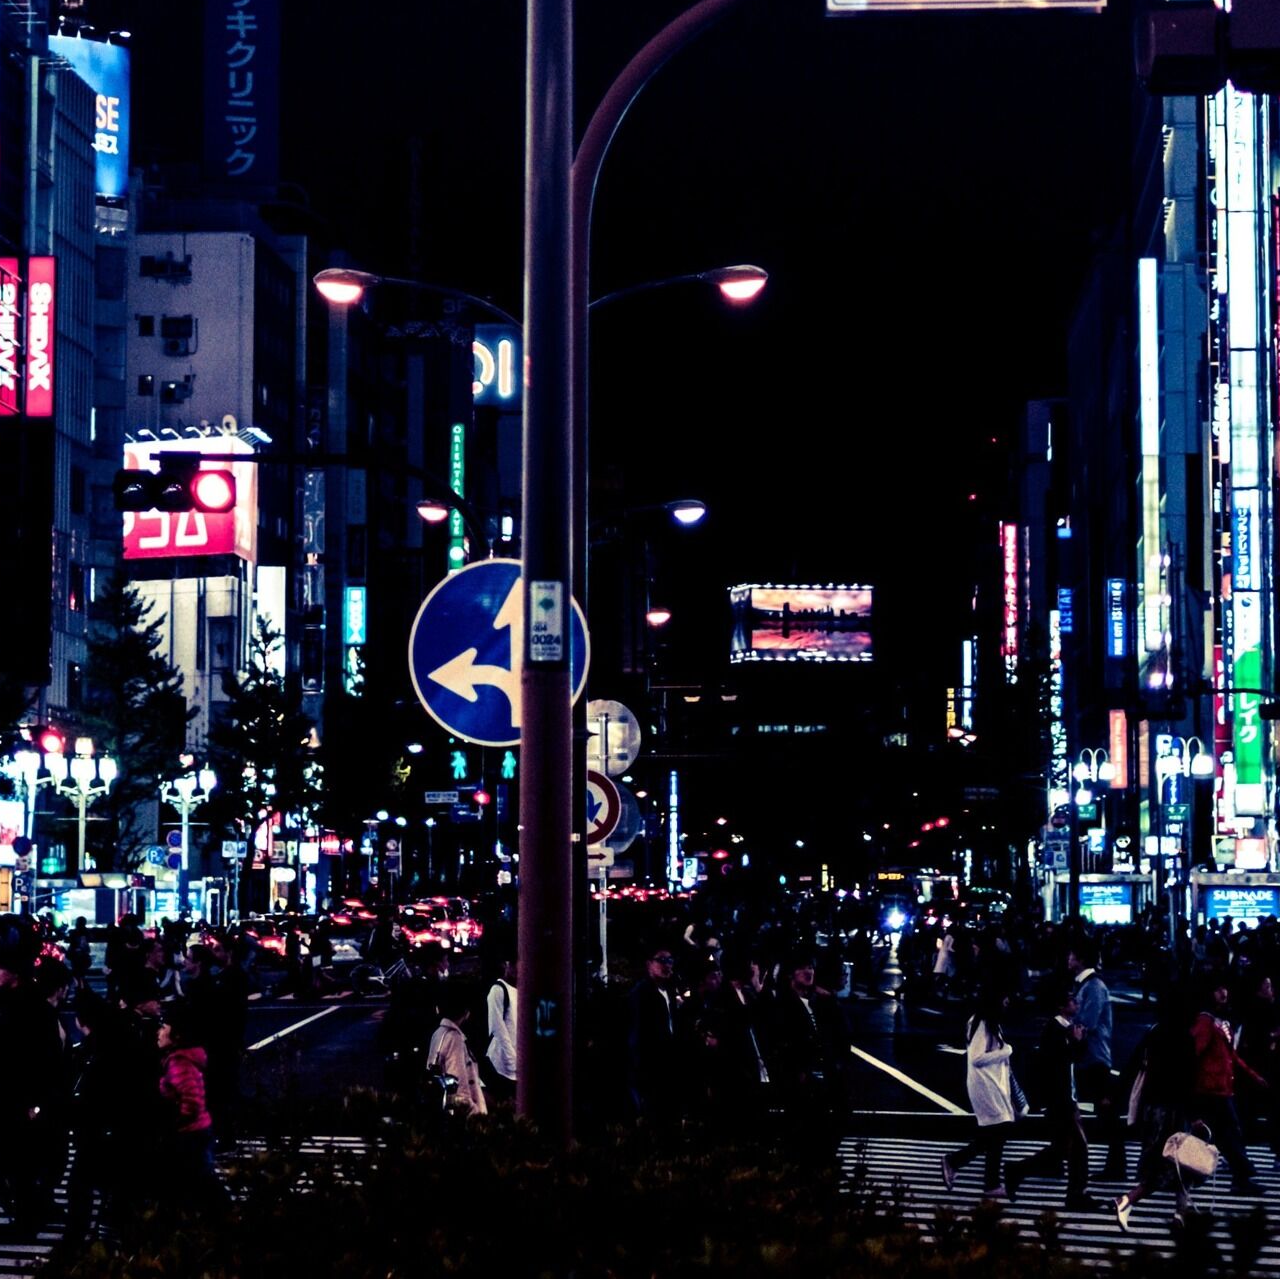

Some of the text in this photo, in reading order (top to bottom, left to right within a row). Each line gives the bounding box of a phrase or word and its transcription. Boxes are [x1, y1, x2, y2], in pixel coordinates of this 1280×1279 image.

[29, 281, 53, 392] SHIDAX
[122, 510, 210, 550] コム
[1212, 889, 1275, 902] SUBNADE
